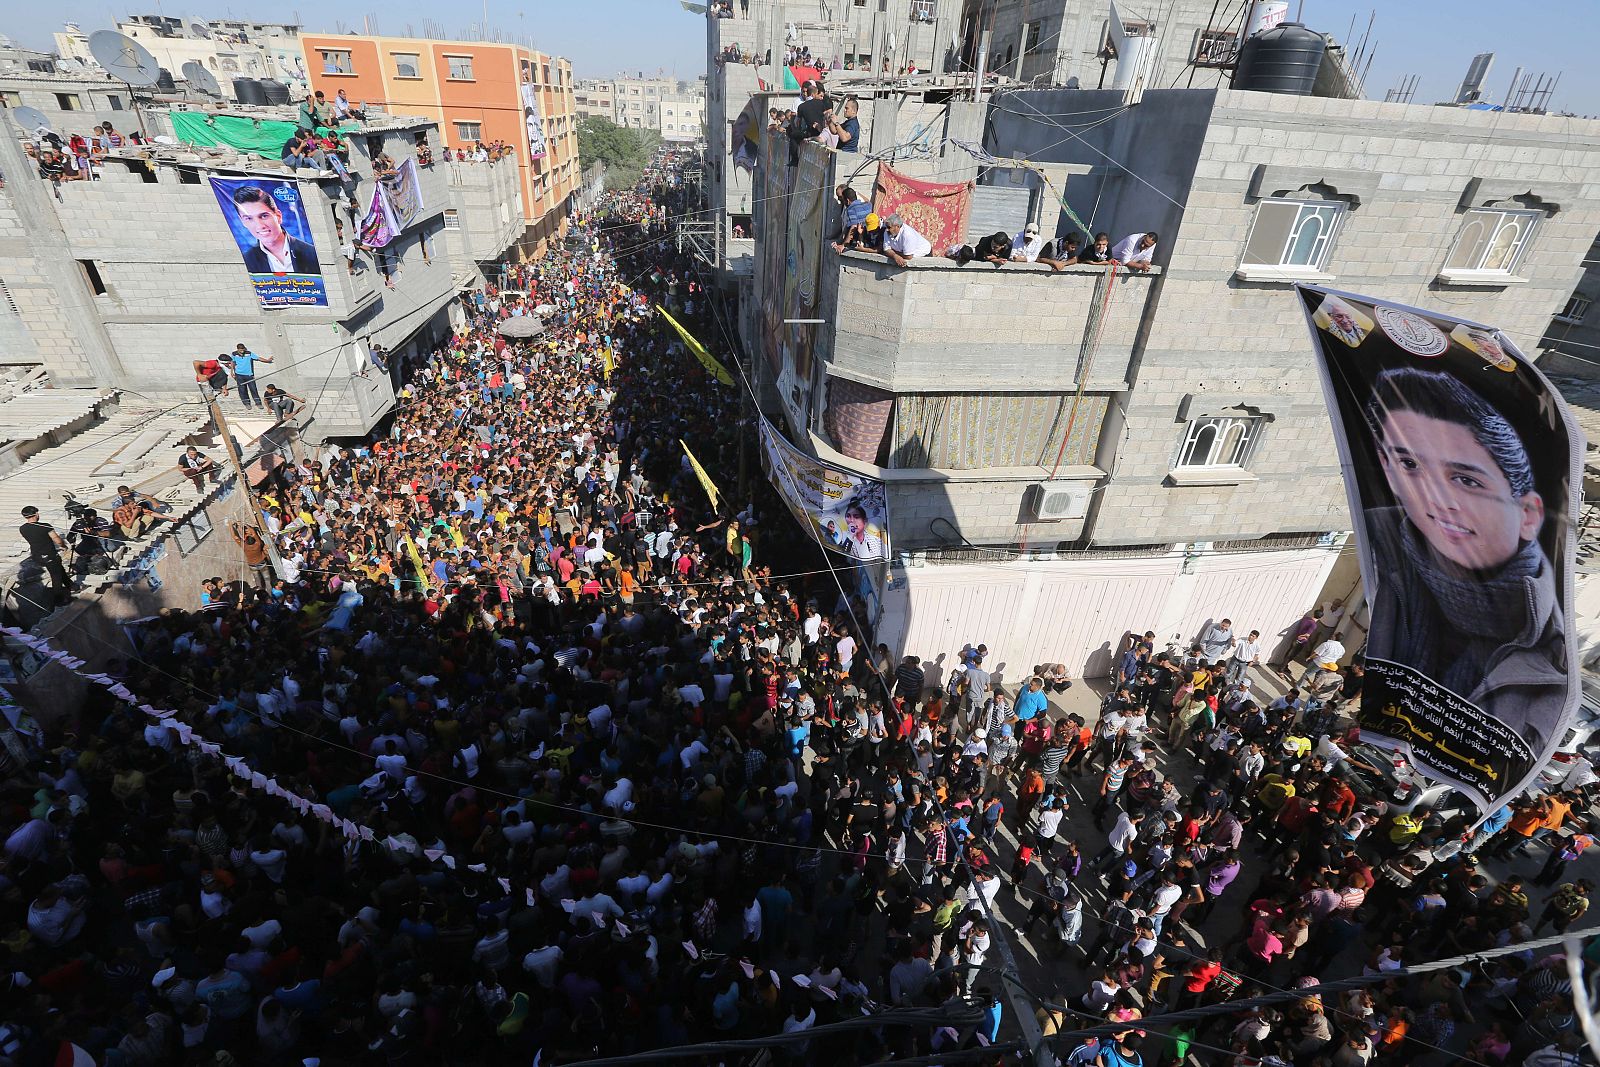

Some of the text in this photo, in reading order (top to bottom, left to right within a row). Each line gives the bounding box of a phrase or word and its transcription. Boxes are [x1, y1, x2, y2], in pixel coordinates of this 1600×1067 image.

[1364, 663, 1388, 675] يونس
[1388, 668, 1406, 676] خان
[1406, 674, 1421, 686] غرب
[1420, 683, 1439, 698] إقليم
[1418, 692, 1445, 714] الشبيبة
[1446, 695, 1482, 722] الفتحاوية
[1445, 712, 1467, 729] وأبناء
[1481, 716, 1511, 740] الشبيبة
[1382, 702, 1498, 780] محمد عساف
[1429, 757, 1459, 774] محبوب
[1477, 782, 1490, 794] على
